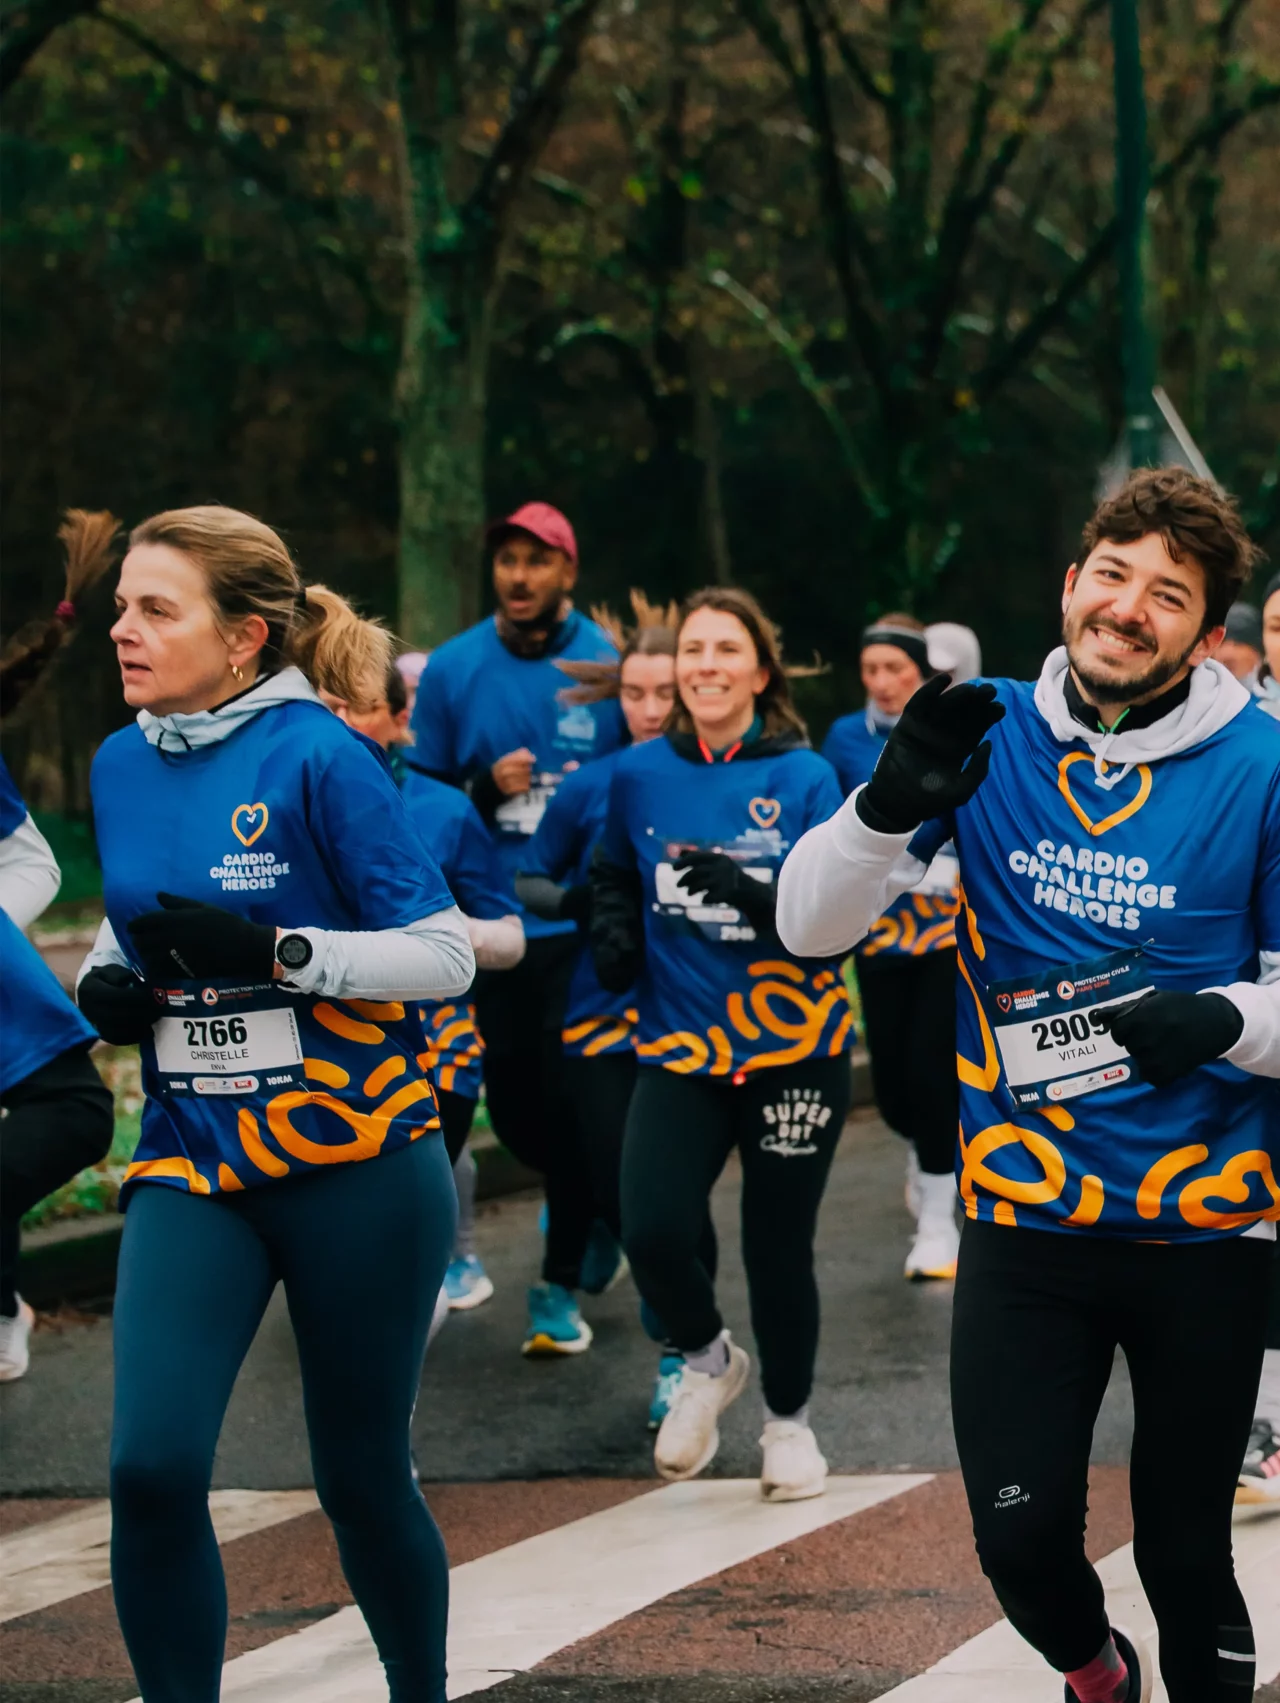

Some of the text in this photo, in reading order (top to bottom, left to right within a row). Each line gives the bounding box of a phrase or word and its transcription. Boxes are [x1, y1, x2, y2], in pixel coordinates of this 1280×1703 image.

[222, 852, 276, 866] CARDIO
[1036, 839, 1149, 881] CARDIO
[209, 862, 290, 879] CHALLENGE
[222, 877, 277, 891] HEROES
[1009, 850, 1177, 909] CHALLENGE
[1033, 882, 1141, 931] HEROES
[1074, 965, 1131, 988] PROTECTION CIVILE
[1014, 990, 1050, 1004] CHALLENGE
[1016, 999, 1038, 1011] HEROES
[183, 1017, 248, 1047] 2766
[1031, 1008, 1111, 1052] 2909
[191, 1048, 250, 1060] CHRISTELLE
[1058, 1044, 1097, 1061] VITALI
[266, 1074, 293, 1086] 10KM
[1020, 1092, 1040, 1103] 10KM
[763, 1102, 832, 1128] SUPER
[995, 1493, 1030, 1508] Kalenji
